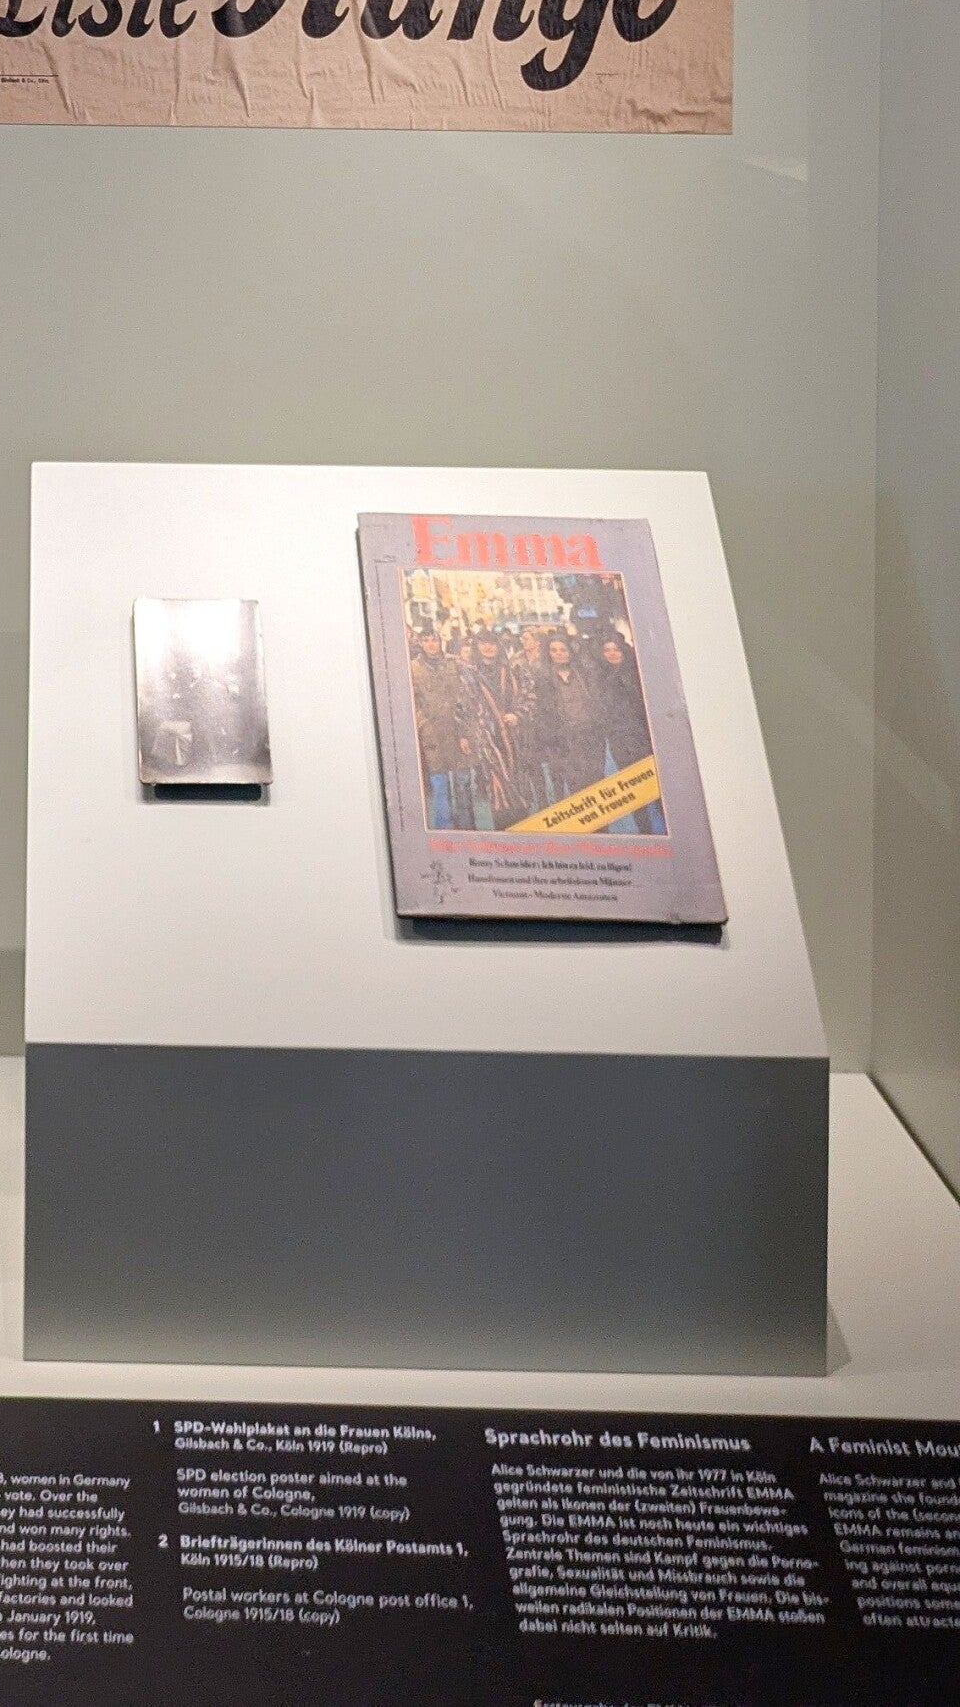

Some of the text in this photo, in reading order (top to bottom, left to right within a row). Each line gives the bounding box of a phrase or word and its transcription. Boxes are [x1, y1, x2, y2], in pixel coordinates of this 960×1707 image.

[412, 515, 602, 569] Emma
[542, 795, 598, 828] Zeitschrift
[617, 768, 654, 792] Frauen
[598, 792, 636, 815] Frauen
[153, 1420, 159, 1432] 1
[174, 1420, 289, 1437] SPD-Wahlplakat
[294, 1426, 310, 1435] an
[314, 1424, 335, 1436] die
[340, 1424, 389, 1437] Frauen
[175, 1437, 229, 1449] Gilsbach
[233, 1438, 243, 1450] &
[276, 1439, 304, 1451] Köln
[308, 1440, 334, 1451] 1919
[339, 1440, 387, 1455] (Repro)
[484, 1427, 750, 1449] Sprachrohr des Feminismus
[810, 1436, 960, 1456] A Feminist Mou
[10, 1475, 55, 1484] women
[59, 1474, 70, 1484] in
[73, 1474, 129, 1489] Germany
[158, 1534, 167, 1547] 2
[180, 1534, 467, 1556] Briefträgerinnen des Kölner Postamts 1,
[183, 1586, 472, 1609] Postal workers at Cologne post office 1,
